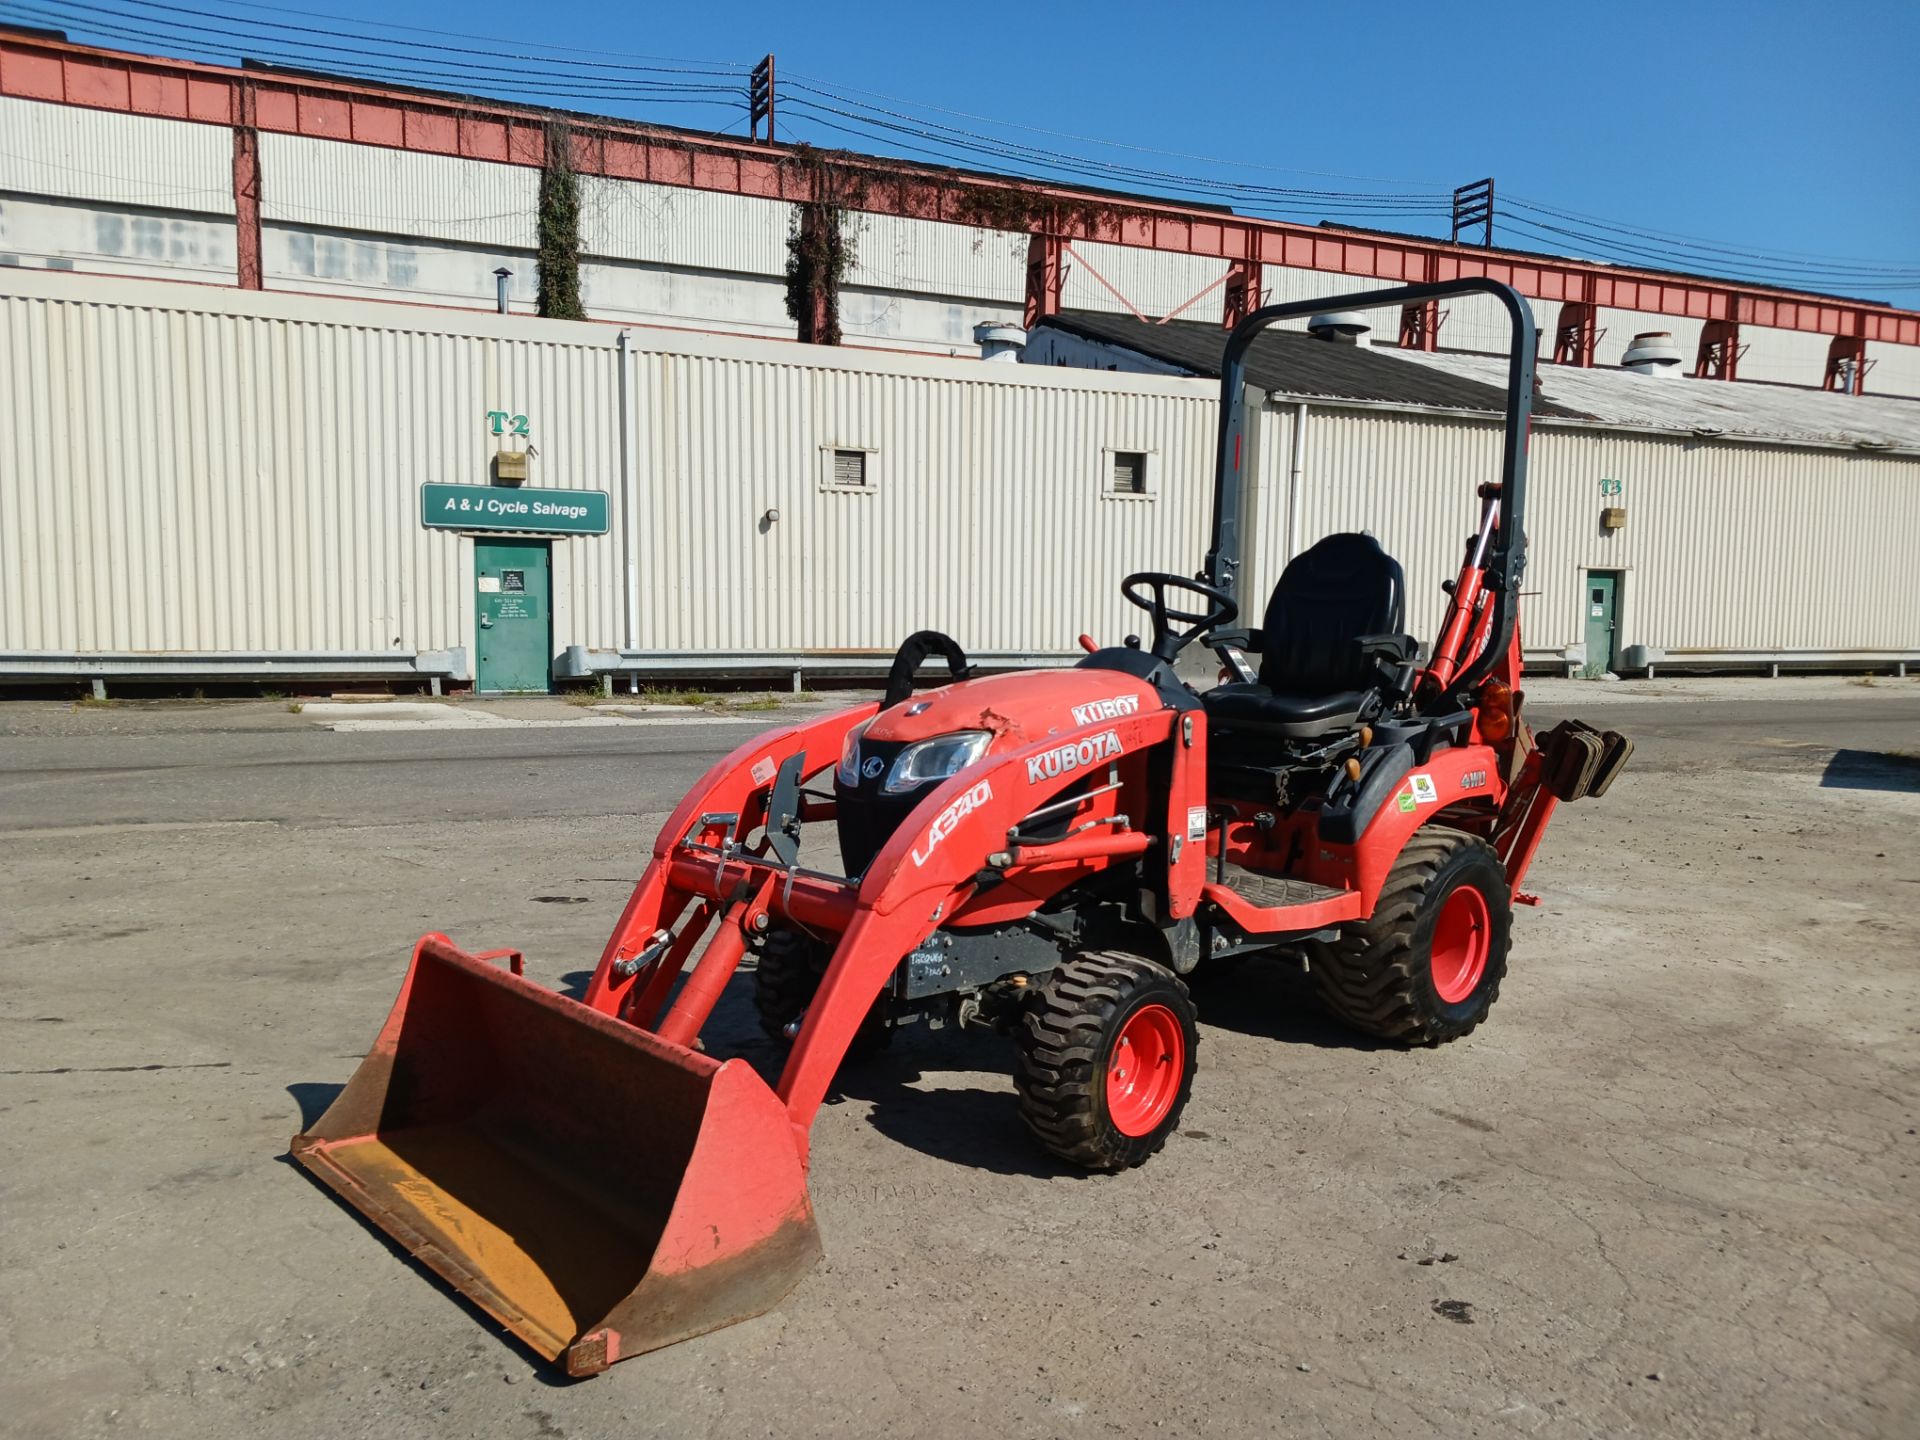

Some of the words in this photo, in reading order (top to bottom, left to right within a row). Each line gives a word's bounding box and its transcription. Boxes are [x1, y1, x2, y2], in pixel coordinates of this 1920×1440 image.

[487, 411, 530, 435] T2
[1600, 479, 1622, 495] T3
[445, 498, 456, 510] A
[460, 499, 471, 511] &
[474, 499, 484, 512] J
[487, 499, 529, 516] Cycle
[532, 501, 588, 519] Salvage
[1025, 730, 1123, 785] KUBOTA
[911, 779, 992, 867] LA340
